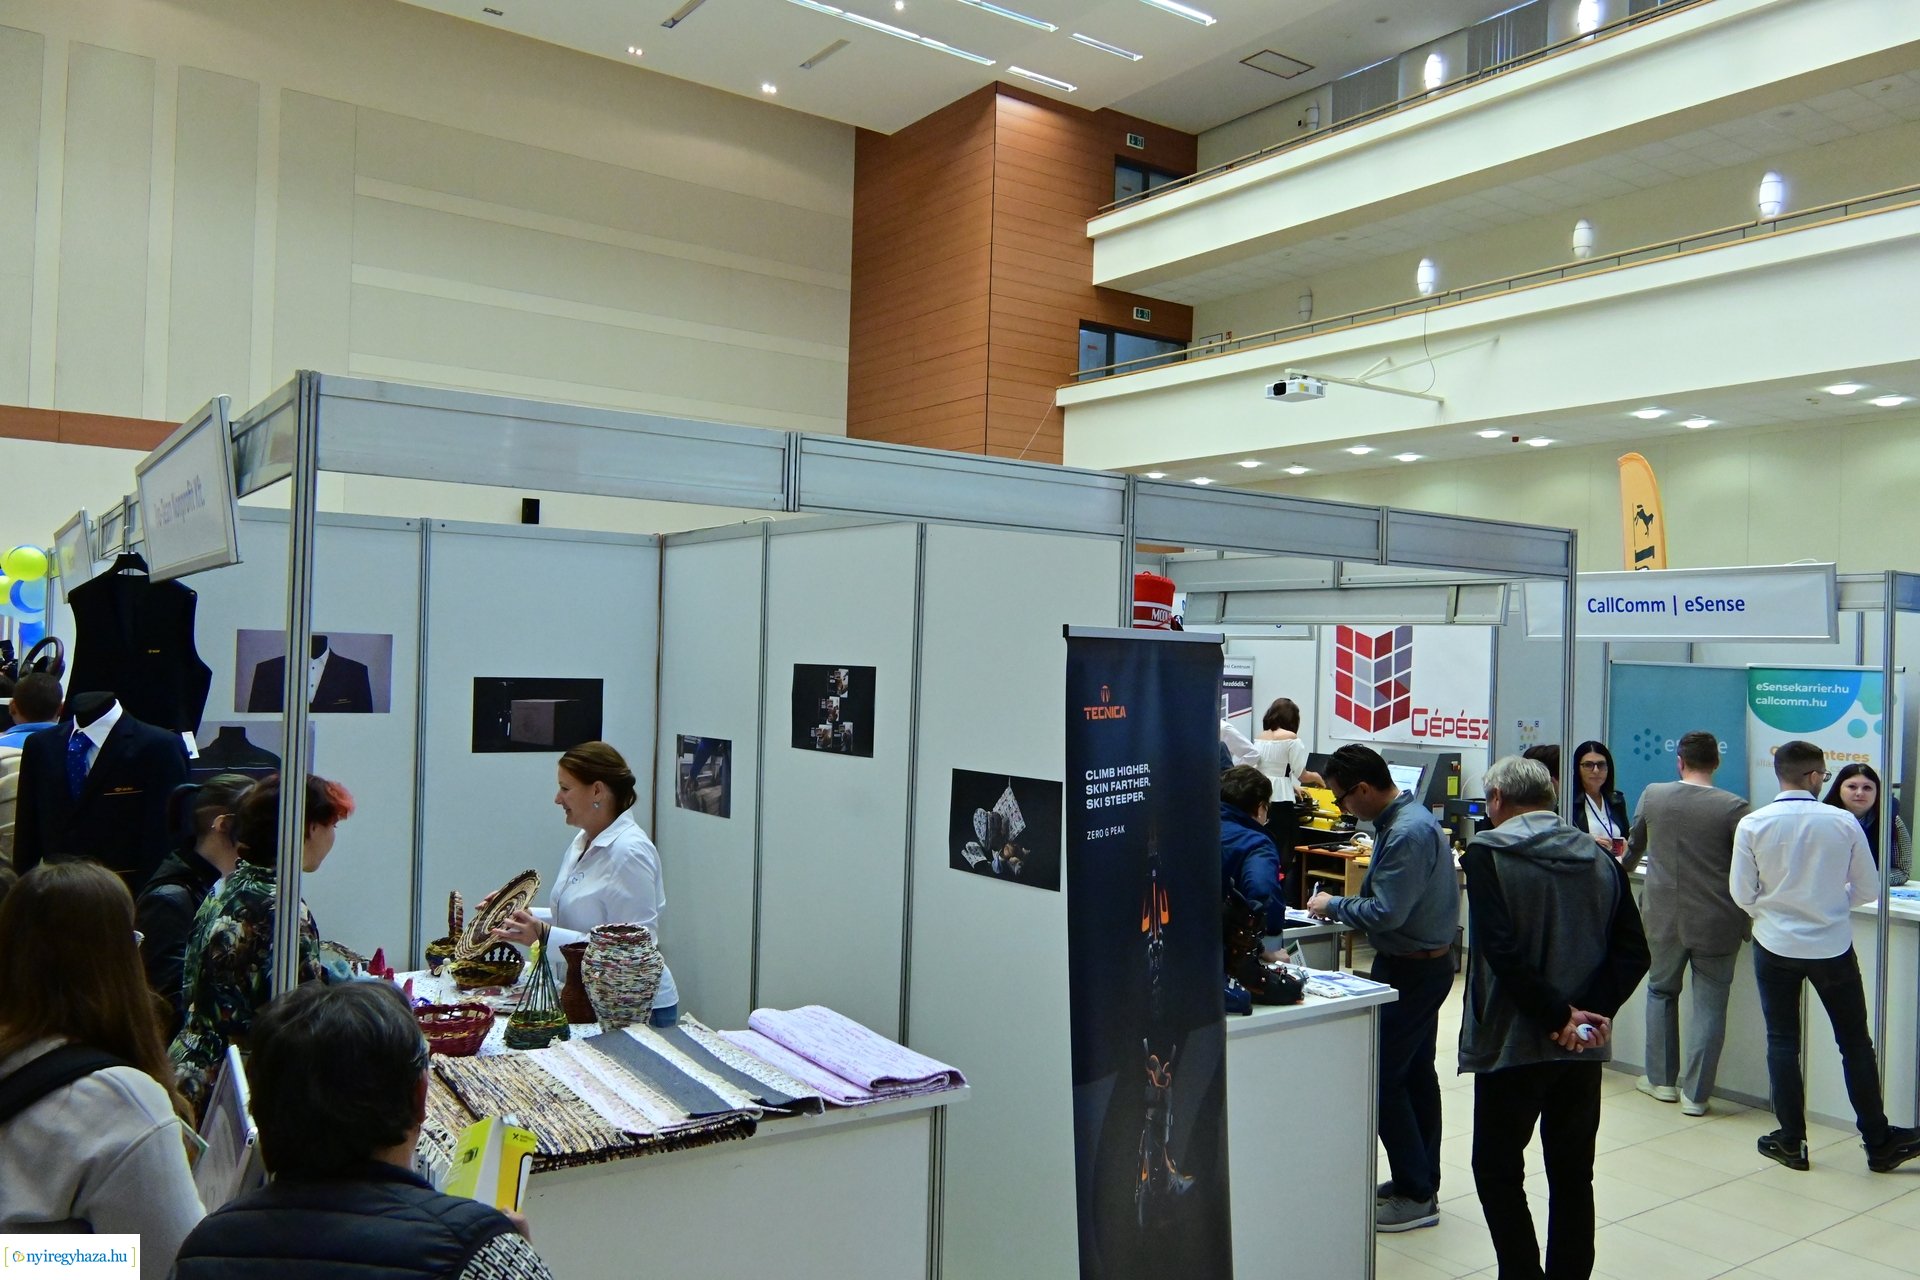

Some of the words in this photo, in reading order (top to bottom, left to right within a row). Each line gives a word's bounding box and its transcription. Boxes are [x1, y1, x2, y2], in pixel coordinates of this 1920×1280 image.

[1587, 597, 1666, 613] CallComm
[1685, 596, 1745, 612] eSense
[1151, 608, 1171, 622] MOO
[1755, 682, 1850, 694] eSensekarrier.hu
[1755, 696, 1828, 707] callcomm.hu
[1083, 705, 1127, 720] TECNICA
[1085, 767, 1115, 781] CLIMB
[1117, 763, 1151, 777] HIGHER,
[1085, 783, 1109, 795] SKIN
[1110, 777, 1151, 792] FARTHER,
[1086, 798, 1103, 810] SKI
[1105, 791, 1146, 807] STEEPER.
[1087, 829, 1104, 840] ZERO
[1104, 827, 1110, 837] G
[1110, 825, 1126, 836] PEAK
